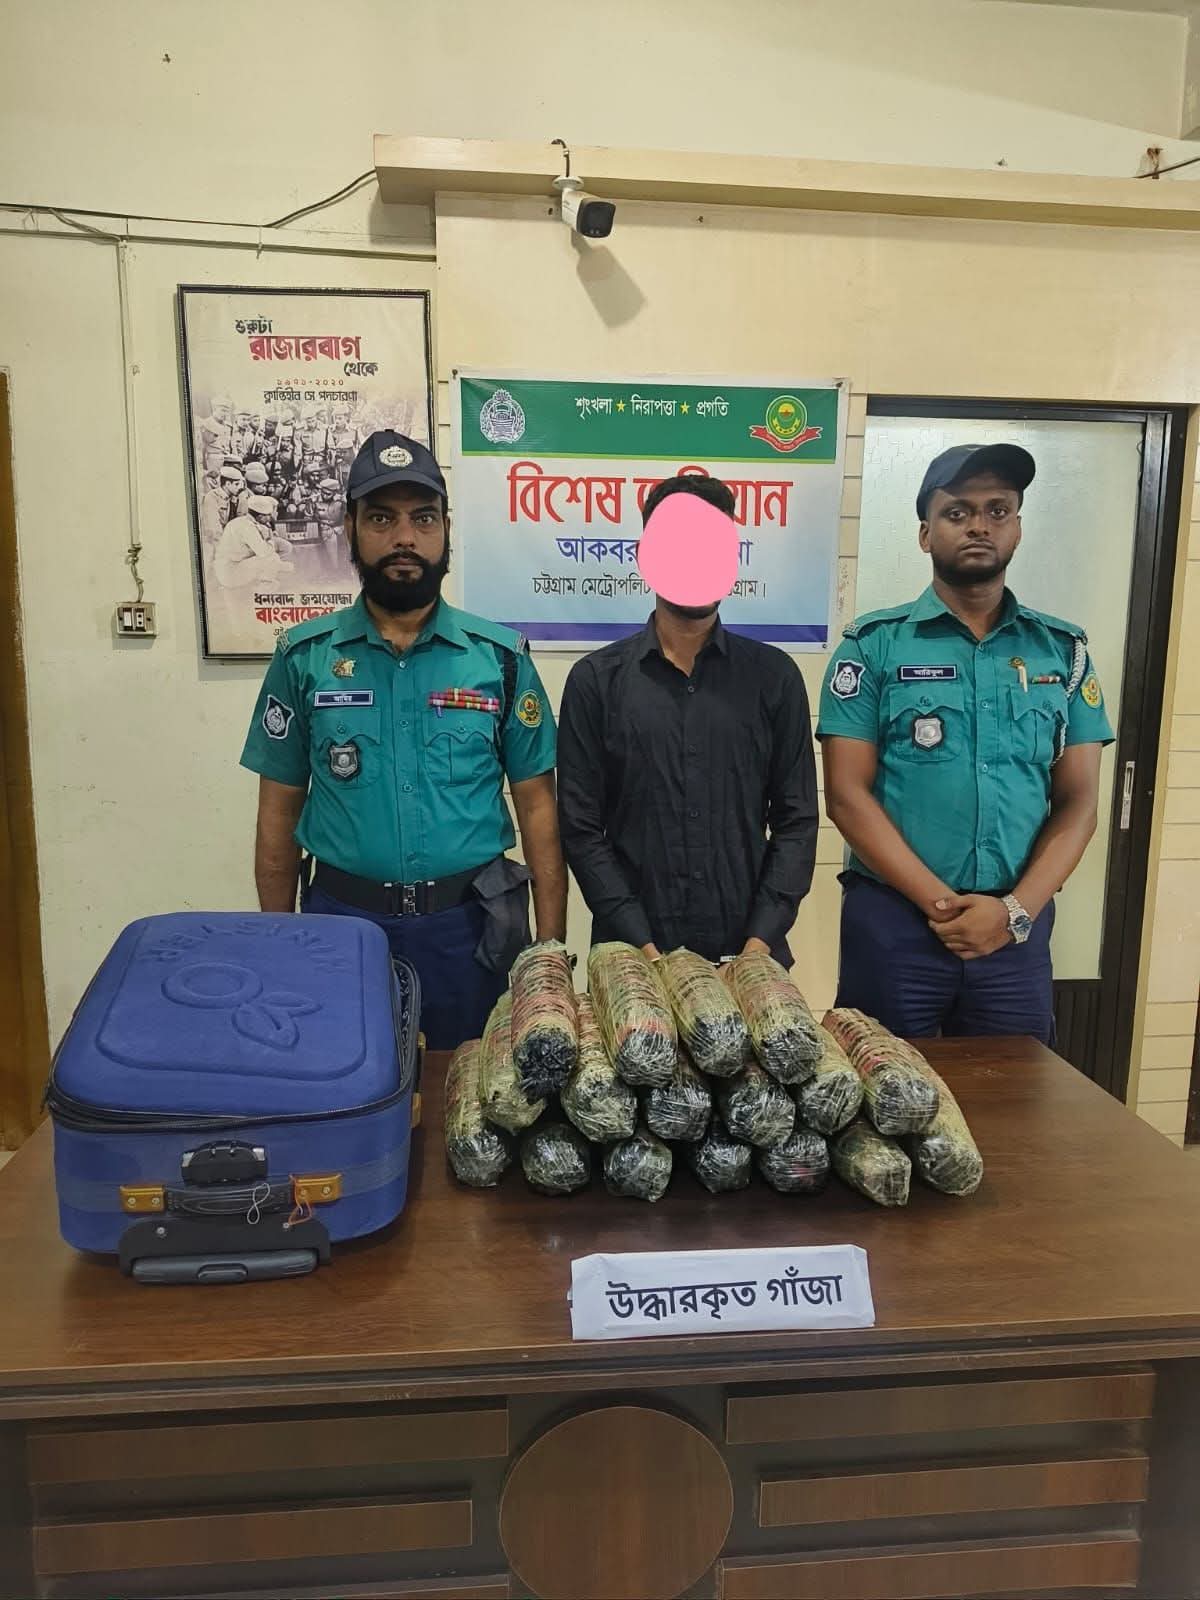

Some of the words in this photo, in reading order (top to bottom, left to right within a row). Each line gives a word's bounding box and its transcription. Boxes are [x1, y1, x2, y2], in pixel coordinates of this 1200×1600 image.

[248, 335, 361, 361] রাজারবাগ
[344, 362, 378, 376] থেকে
[575, 397, 613, 420] শৃংখলা
[630, 394, 677, 417] নিরাপত্তা
[696, 396, 729, 417] প্রগতি
[507, 461, 626, 524] বিশেষ
[532, 571, 577, 595] চট্টগ্রাম
[605, 1280, 757, 1320] উদ্ধারকৃত
[766, 1265, 843, 1306] গাঁজা
